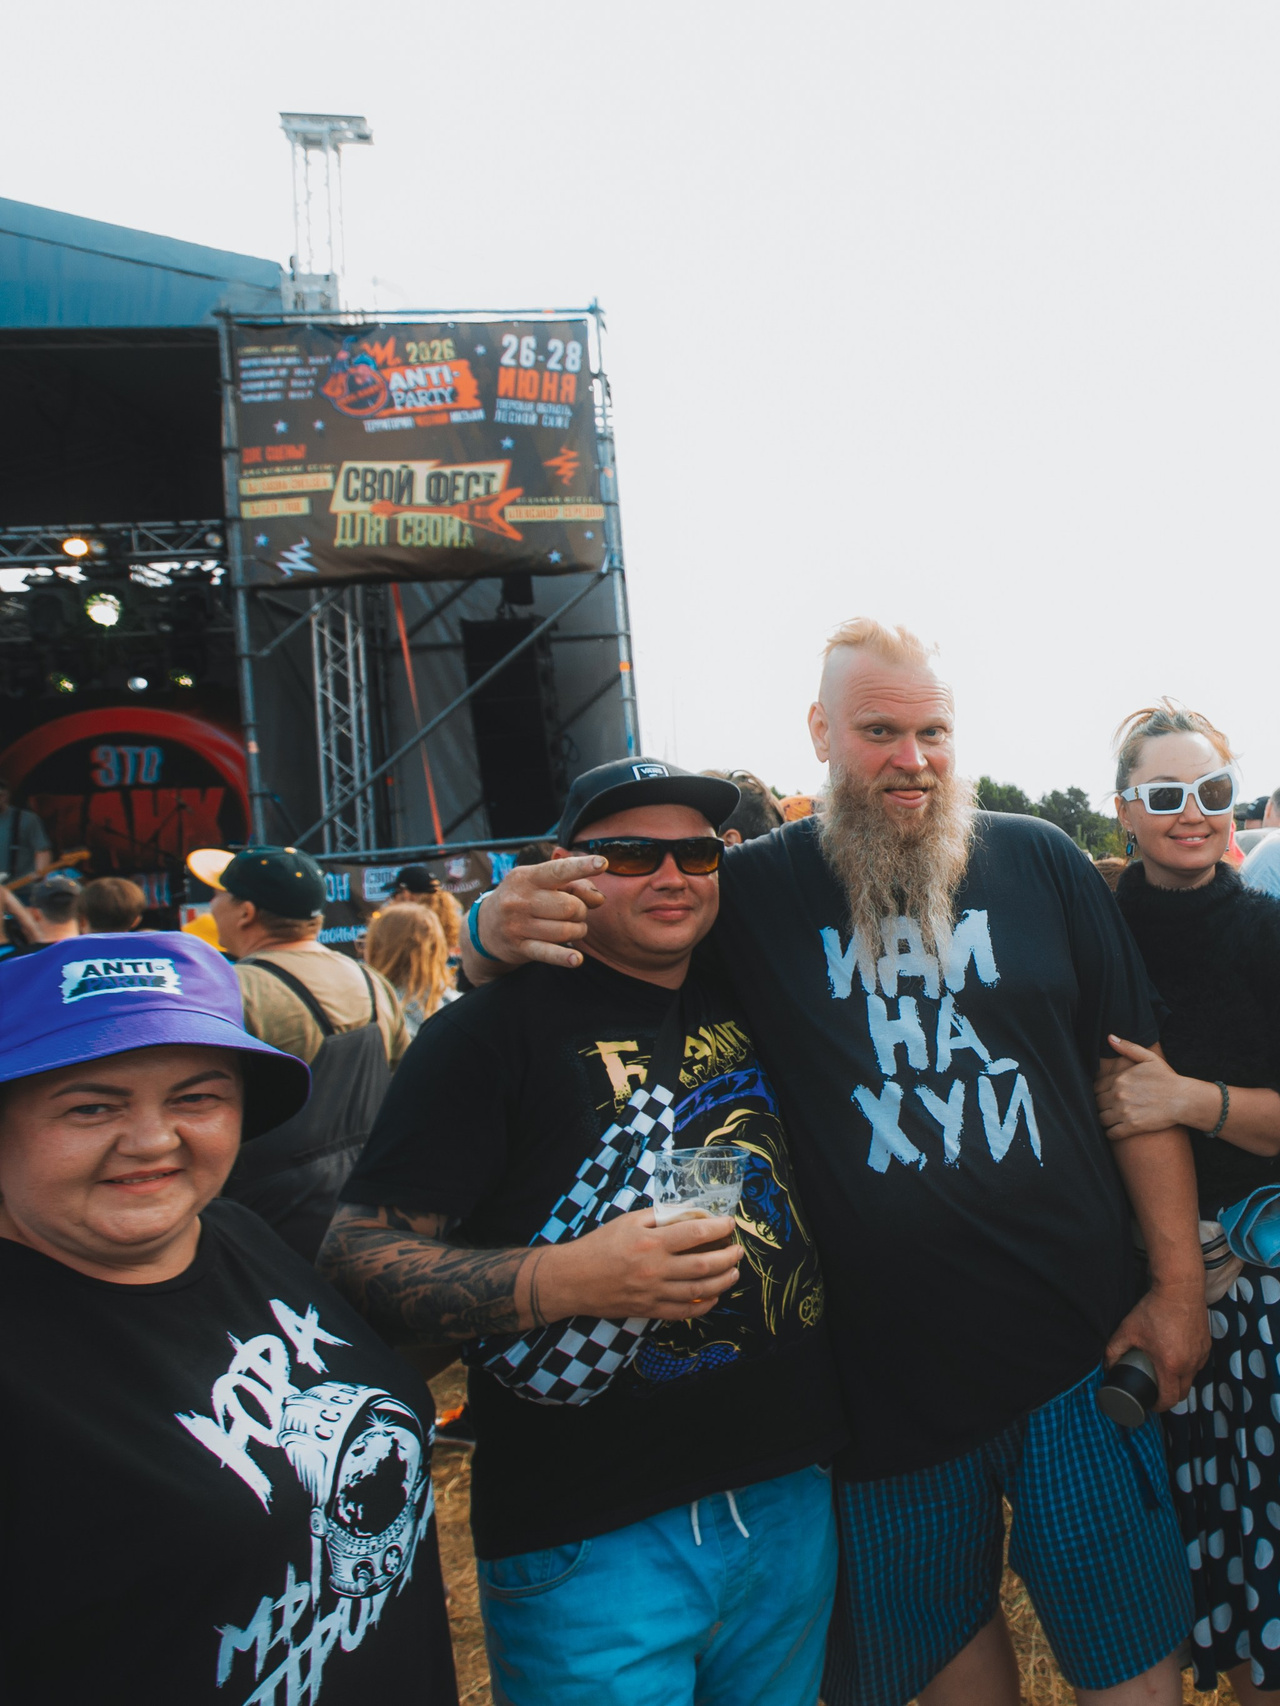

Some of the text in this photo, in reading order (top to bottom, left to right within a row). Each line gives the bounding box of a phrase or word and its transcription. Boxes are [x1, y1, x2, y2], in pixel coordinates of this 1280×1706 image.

[406, 338, 456, 364] 2026
[500, 333, 582, 373] 26-28
[392, 386, 457, 410] PARTY
[497, 366, 577, 404] ИЮНЯ
[343, 465, 415, 505] СВОЙ
[425, 470, 496, 506] ФЕСТ
[334, 511, 389, 549] ДЛЯ
[90, 745, 164, 787] ЭТО
[866, 992, 993, 1077] НА
[851, 1057, 1044, 1175] ХУЙ
